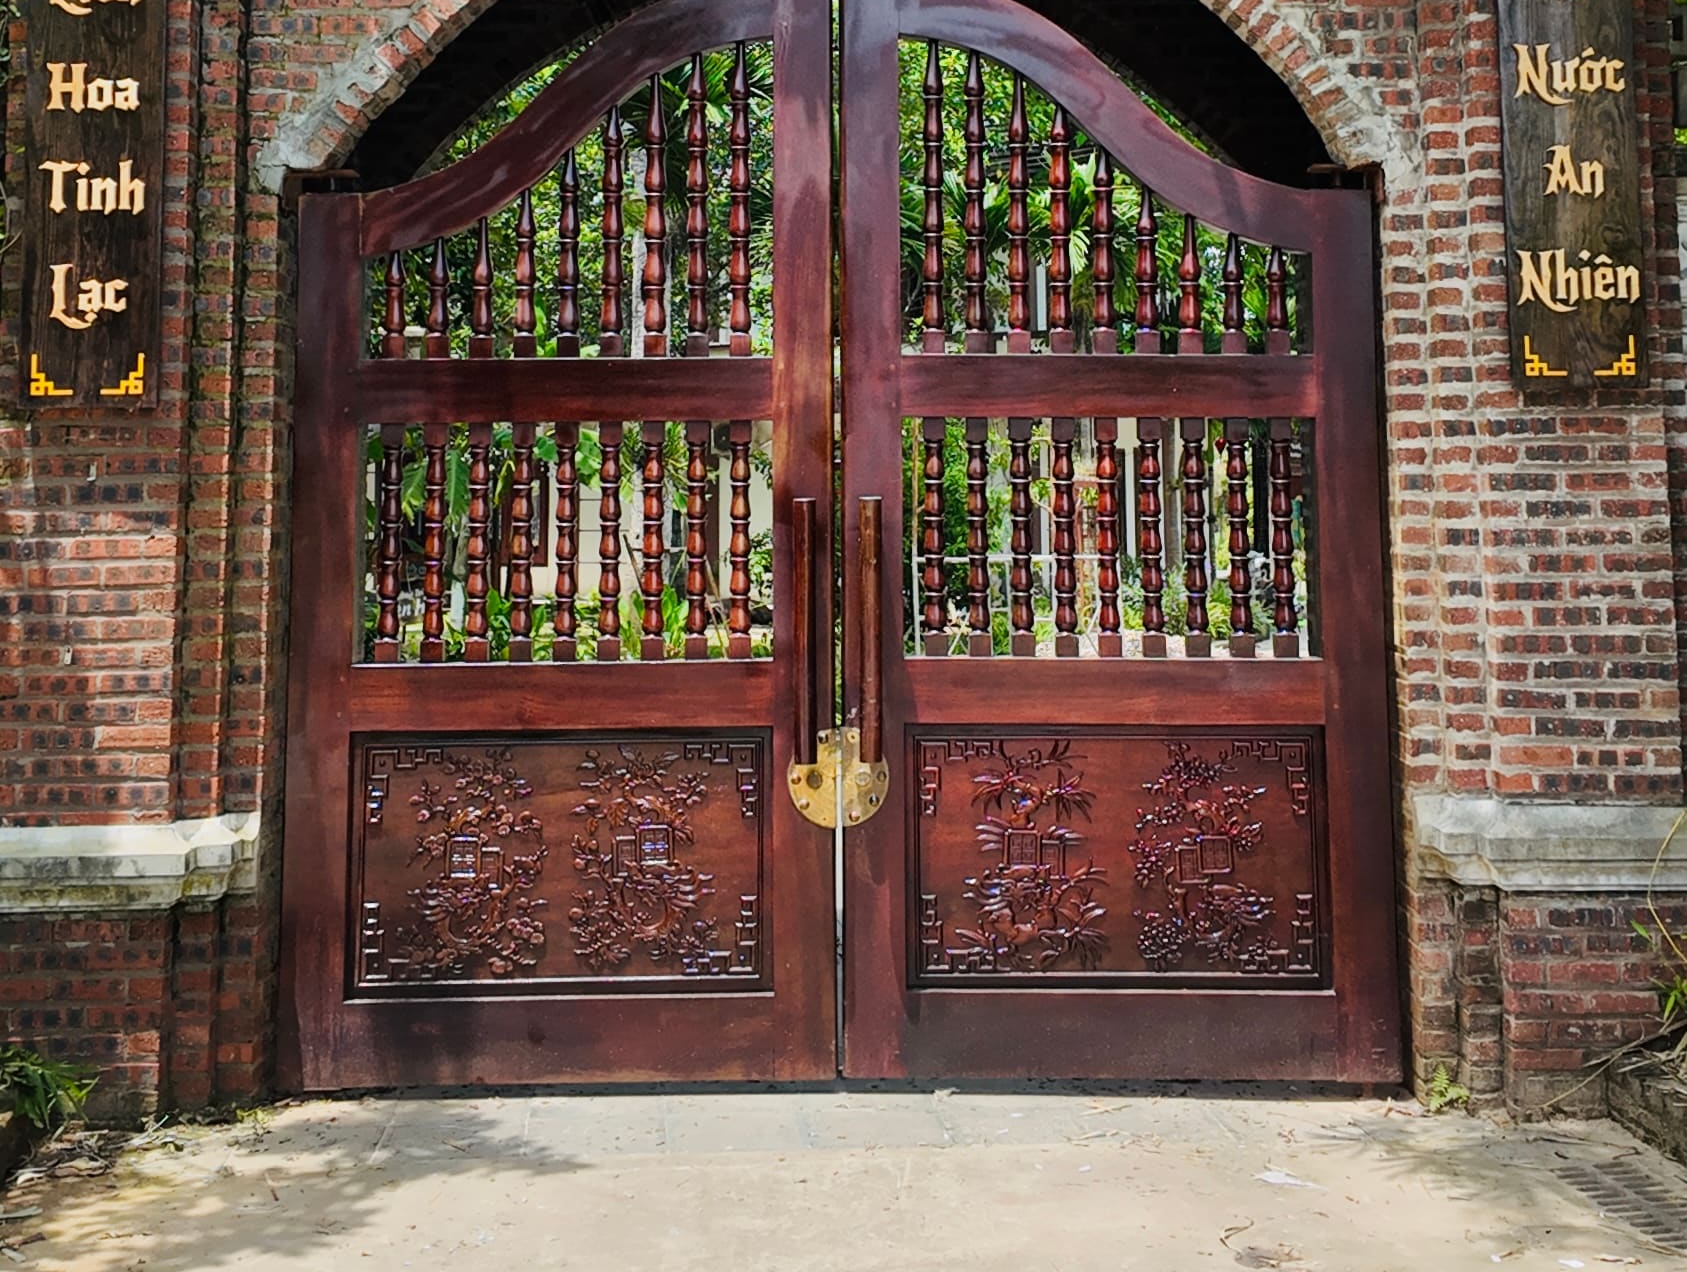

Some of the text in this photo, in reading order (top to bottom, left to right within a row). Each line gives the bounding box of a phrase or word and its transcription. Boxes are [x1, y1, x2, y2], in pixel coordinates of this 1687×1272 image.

[46, 62, 141, 113] Hoa
[1511, 43, 1626, 106] Nước
[1543, 144, 1604, 199] An
[49, 263, 129, 329] Lạc
[1516, 248, 1641, 312] Nhiên
